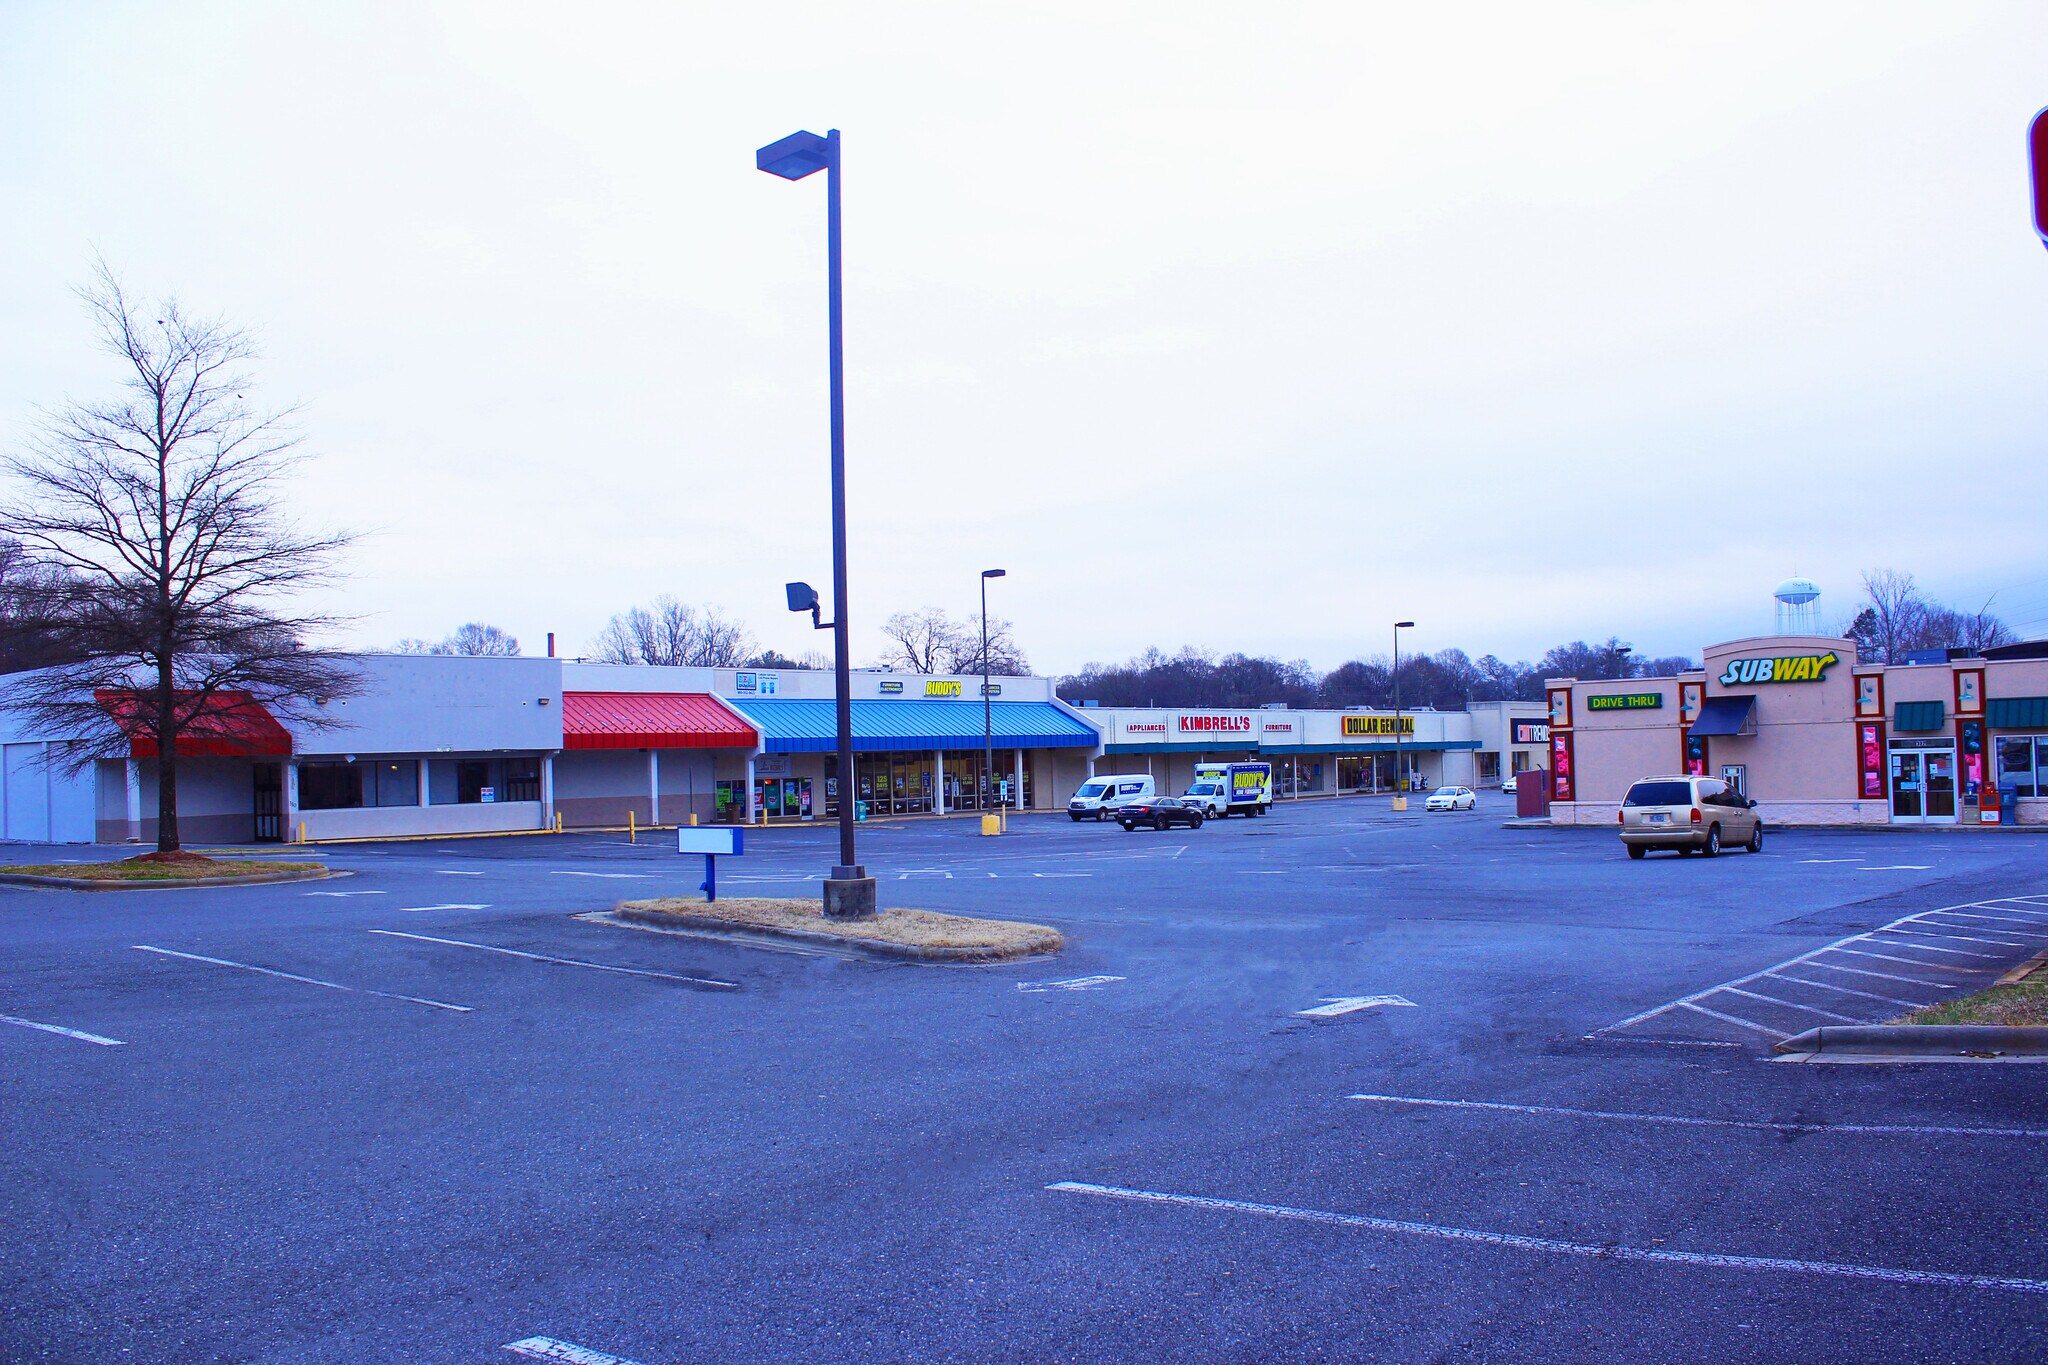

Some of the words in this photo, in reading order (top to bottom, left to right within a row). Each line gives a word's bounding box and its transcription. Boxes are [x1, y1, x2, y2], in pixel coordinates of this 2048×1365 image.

[1720, 653, 1836, 686] SUBWAY
[926, 681, 961, 696] BUDDY'S
[1593, 697, 1623, 708] DRIVE
[1627, 696, 1655, 707] THRU
[1181, 715, 1250, 731] KIMBRELL'S
[1347, 718, 1378, 733] DOLLAR
[1380, 718, 1414, 733] GENRAL
[876, 775, 888, 783] 125
[1234, 771, 1265, 787] BUDDY'S
